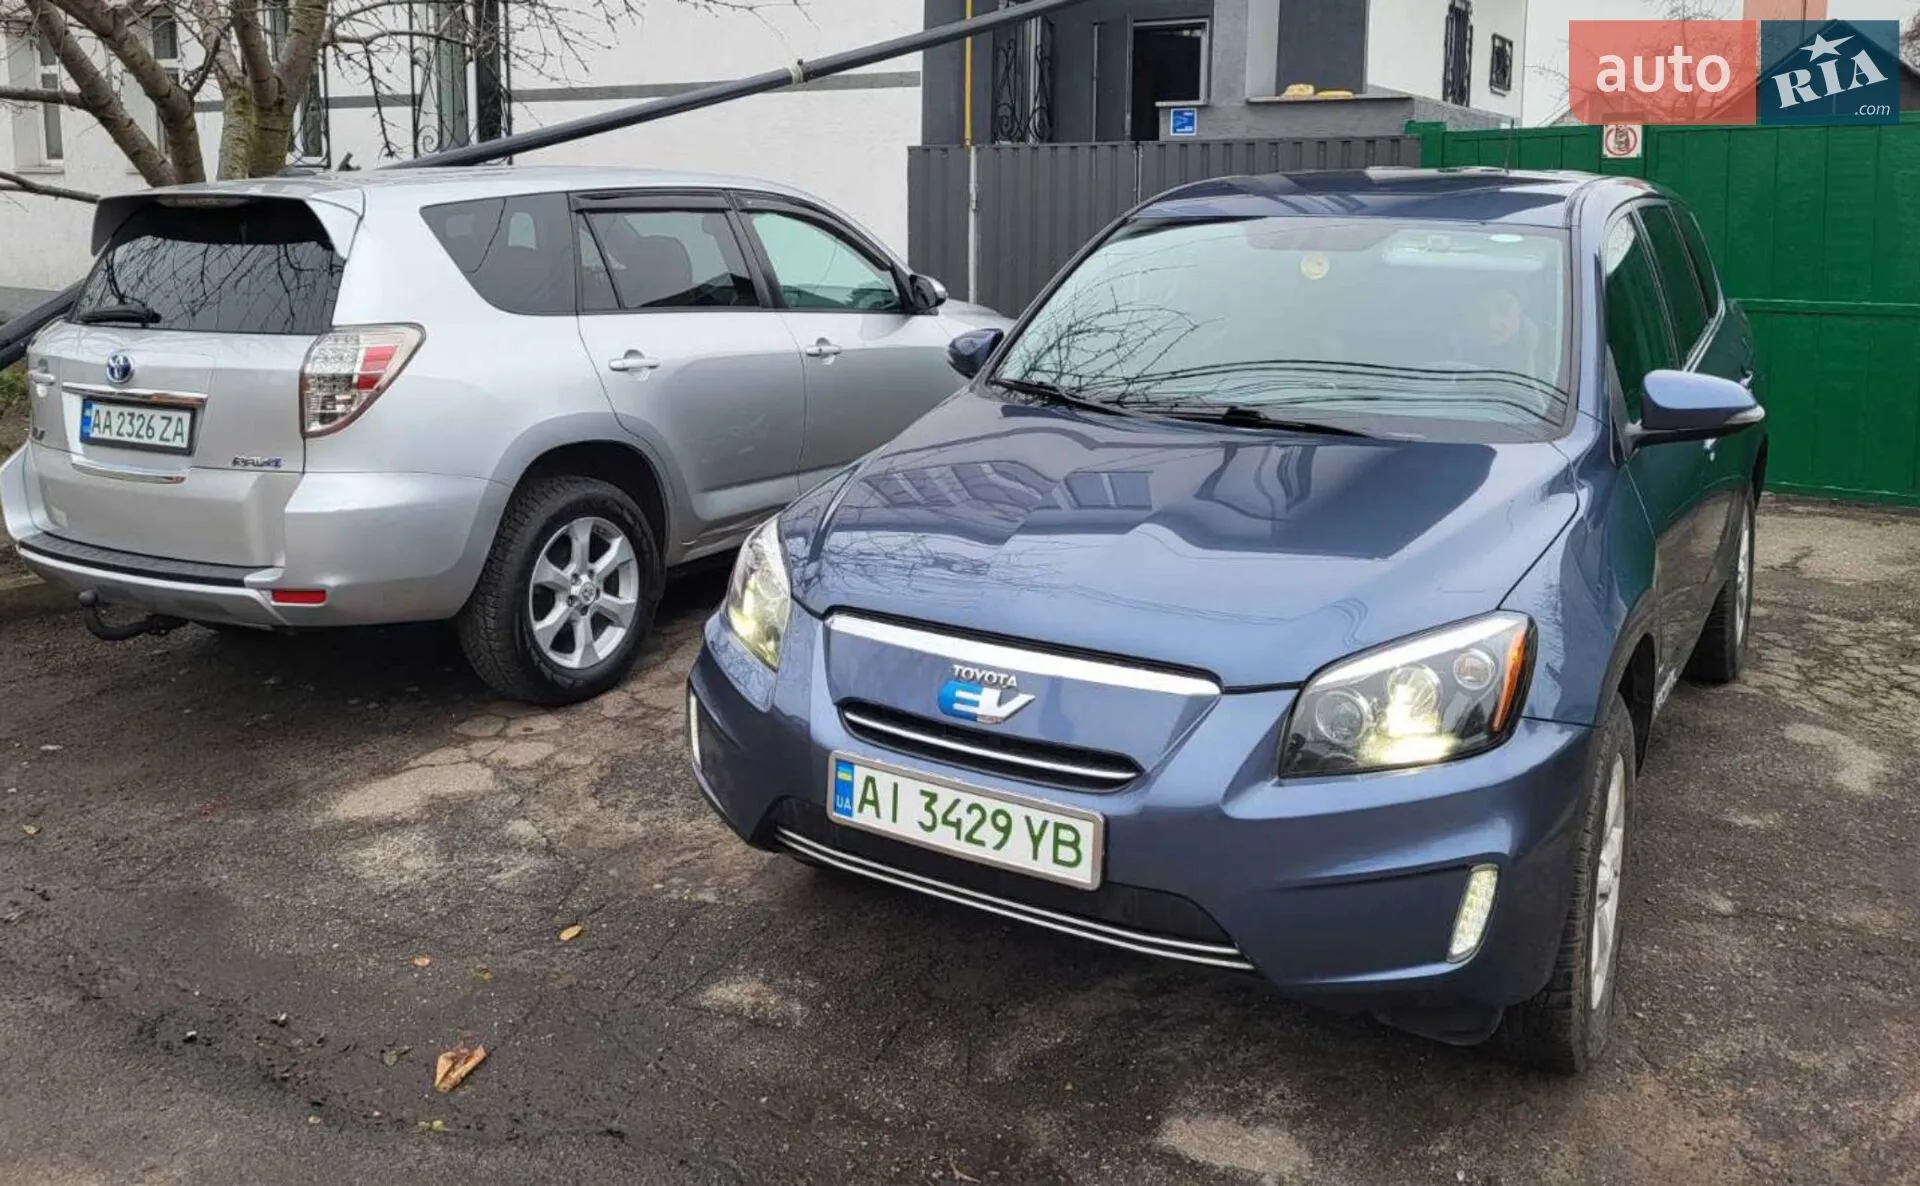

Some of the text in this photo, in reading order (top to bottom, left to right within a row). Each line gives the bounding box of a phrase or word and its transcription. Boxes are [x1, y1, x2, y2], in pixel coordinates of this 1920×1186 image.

[92, 409, 185, 443] AA 2326 ZA
[953, 663, 1018, 689] TOYOTA
[938, 680, 1036, 723] EV
[836, 794, 852, 810] UA
[857, 775, 1082, 869] AI 3429 YB
